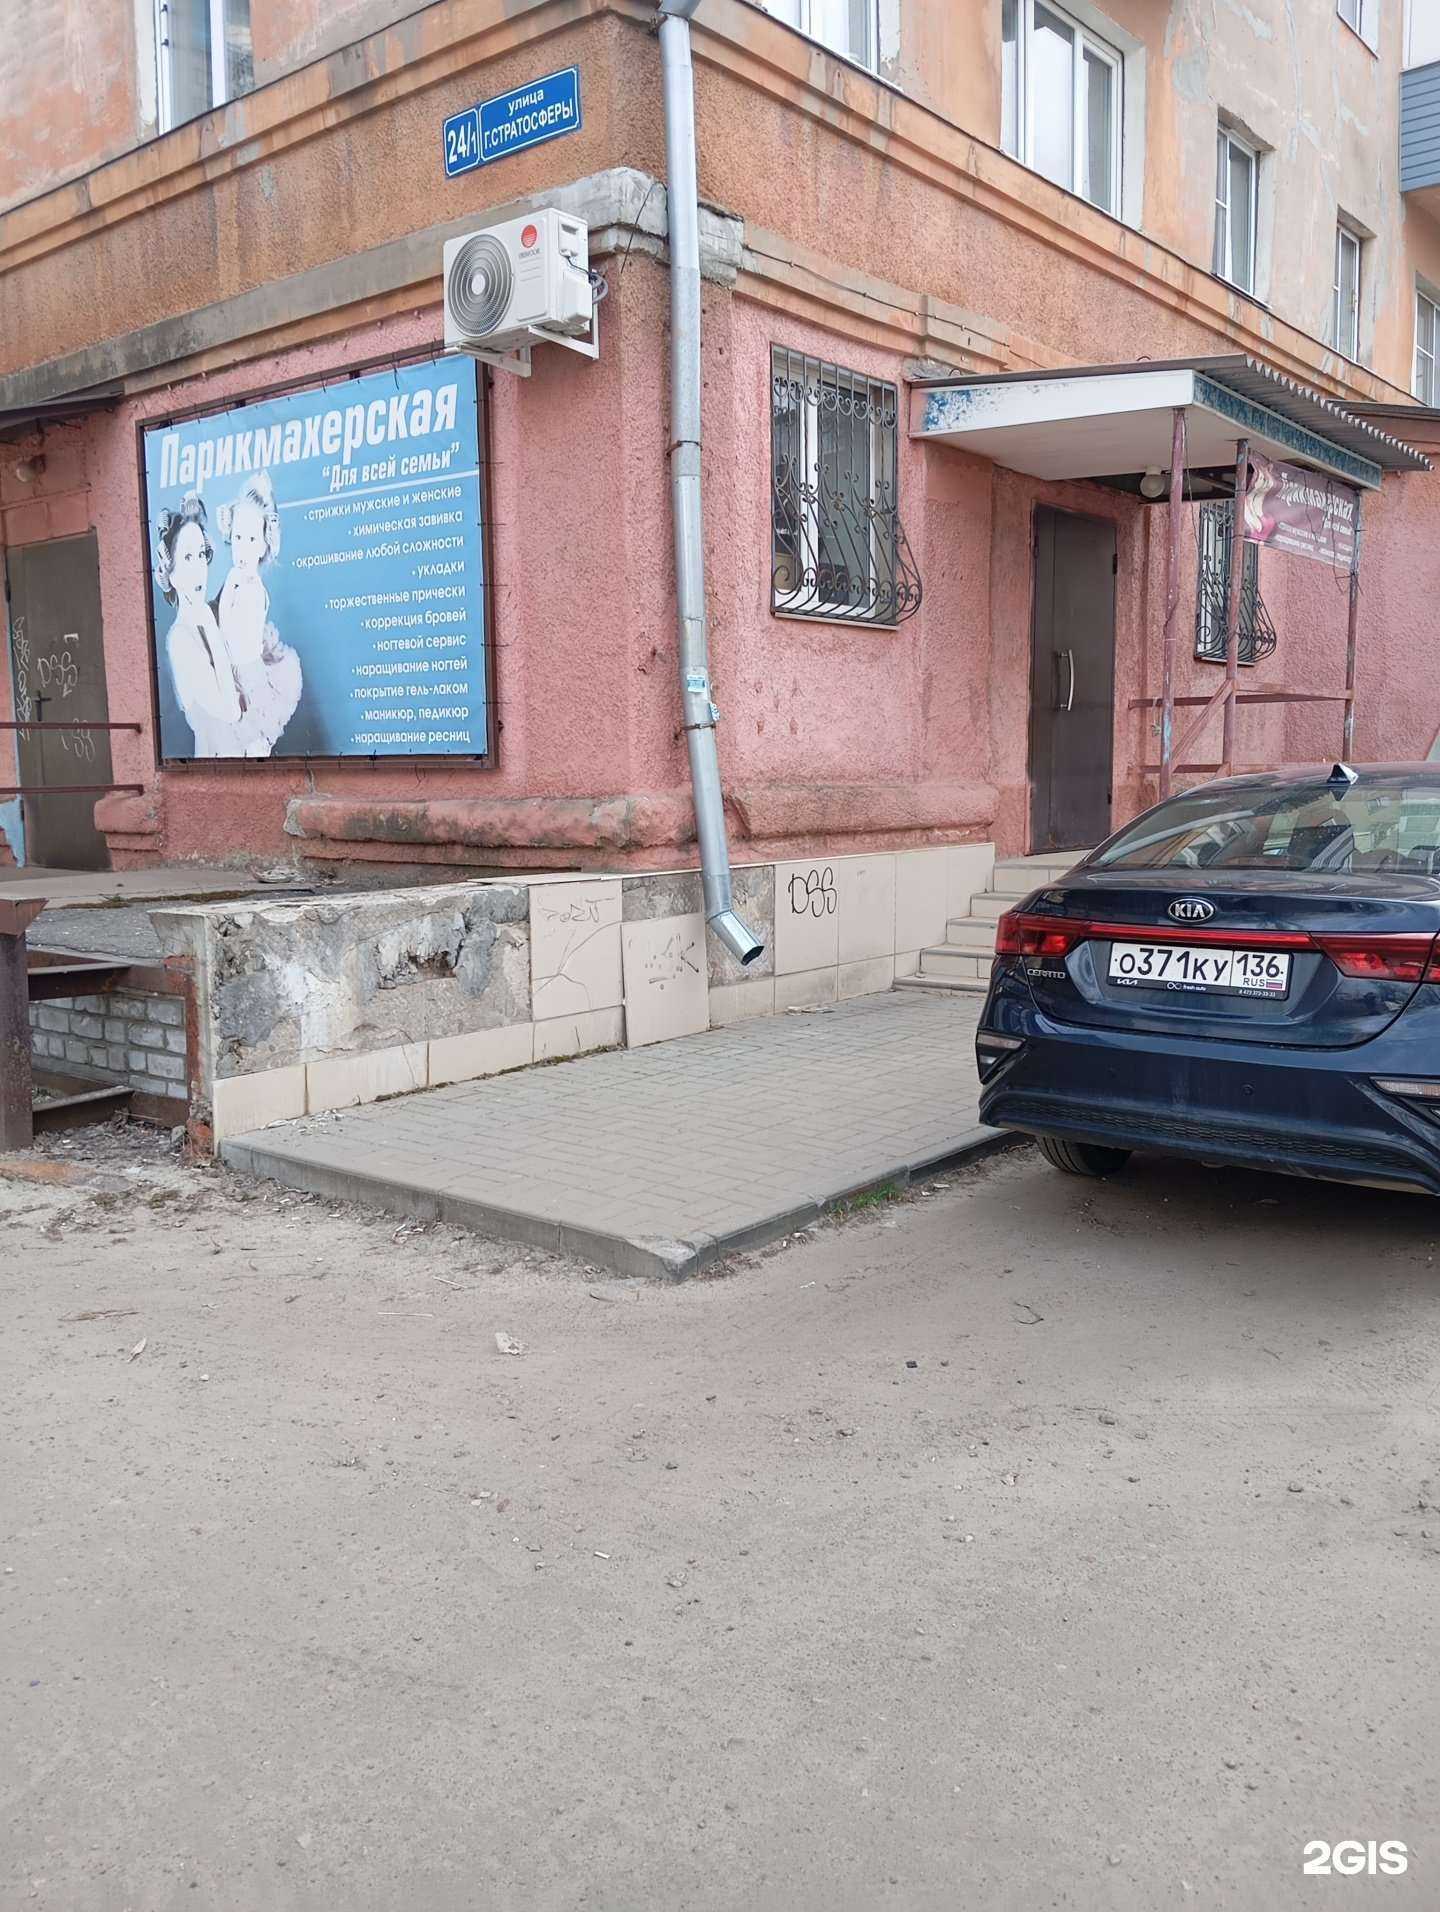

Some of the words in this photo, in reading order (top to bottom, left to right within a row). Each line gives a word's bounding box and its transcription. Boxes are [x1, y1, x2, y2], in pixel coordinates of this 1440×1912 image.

[508, 88, 545, 116] улица
[484, 98, 573, 150] Г.СТРАТОСФЕРЫ
[447, 121, 477, 164] 24/1
[160, 384, 458, 493] Парикмахерская
[362, 454, 396, 482] всей
[308, 503, 351, 522] стрижки
[352, 495, 400, 516] мужские
[402, 494, 410, 505] и
[412, 486, 462, 504] женские
[353, 515, 417, 537] химическая
[419, 511, 463, 527] завивка
[296, 548, 364, 569] окрашивание
[366, 541, 401, 559] любой
[402, 536, 464, 554] сложности
[418, 561, 465, 579] укладки
[329, 592, 409, 611] торжественные
[412, 585, 465, 602] прически
[365, 614, 423, 631] коррекция
[425, 607, 466, 627] бровей
[377, 634, 424, 651] ногтевой
[426, 634, 467, 650] сервис
[356, 661, 429, 677] наращивание
[431, 656, 467, 671] ногтей
[354, 685, 404, 700] покрытие
[406, 683, 468, 696] гель-лаком
[364, 709, 417, 722] маникюр,
[419, 707, 469, 721] педикюр
[355, 731, 426, 745] наращивание
[428, 731, 471, 744] ресниц
[1175, 903, 1206, 918] KIA
[1119, 947, 1229, 982] О371КУ
[1236, 953, 1280, 978] 136
[1243, 977, 1265, 987] RUS
